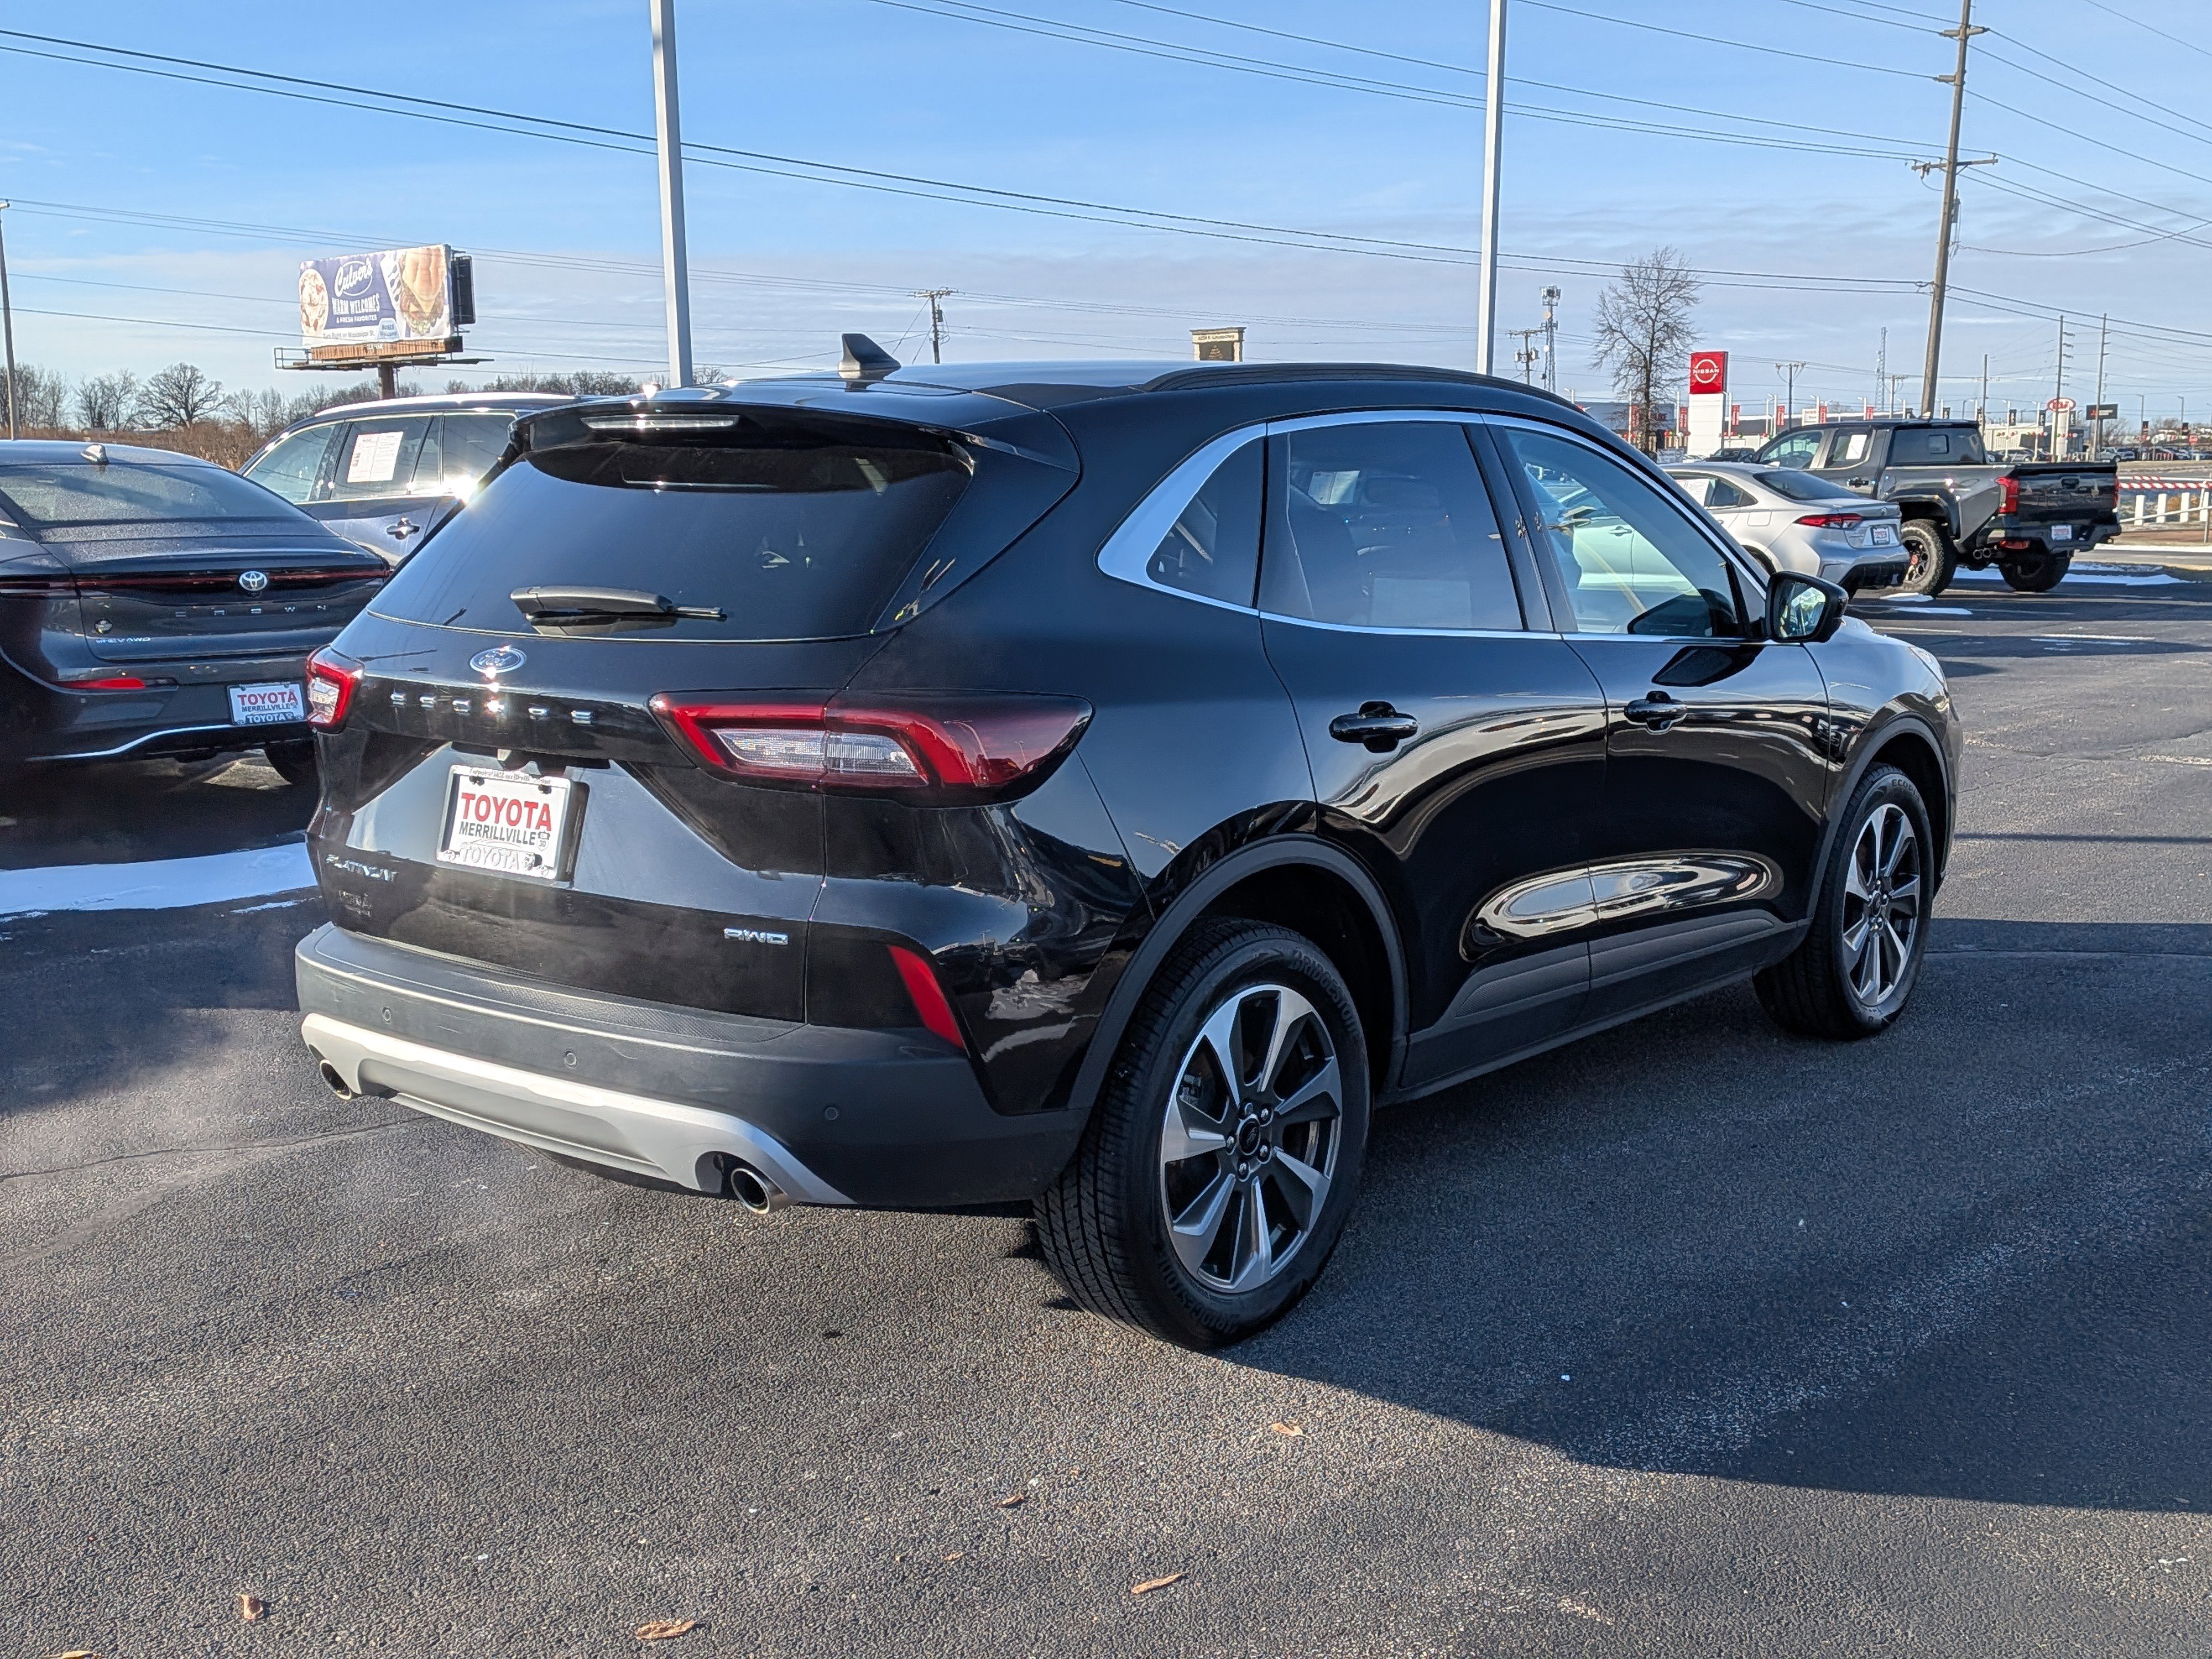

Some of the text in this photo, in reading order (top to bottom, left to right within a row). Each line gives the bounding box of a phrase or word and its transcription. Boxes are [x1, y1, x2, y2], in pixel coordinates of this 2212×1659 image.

[332, 293, 380, 315] WARM WELCOMES
[237, 690, 298, 706] TOYOTA
[242, 703, 290, 712] MERRILLVILLE
[247, 713, 286, 723] TOYOTA
[461, 792, 551, 831] TOYOTA
[459, 821, 536, 845] MERRILLVILLE
[460, 845, 519, 870] TOYOTA
[723, 928, 788, 945] AWD
